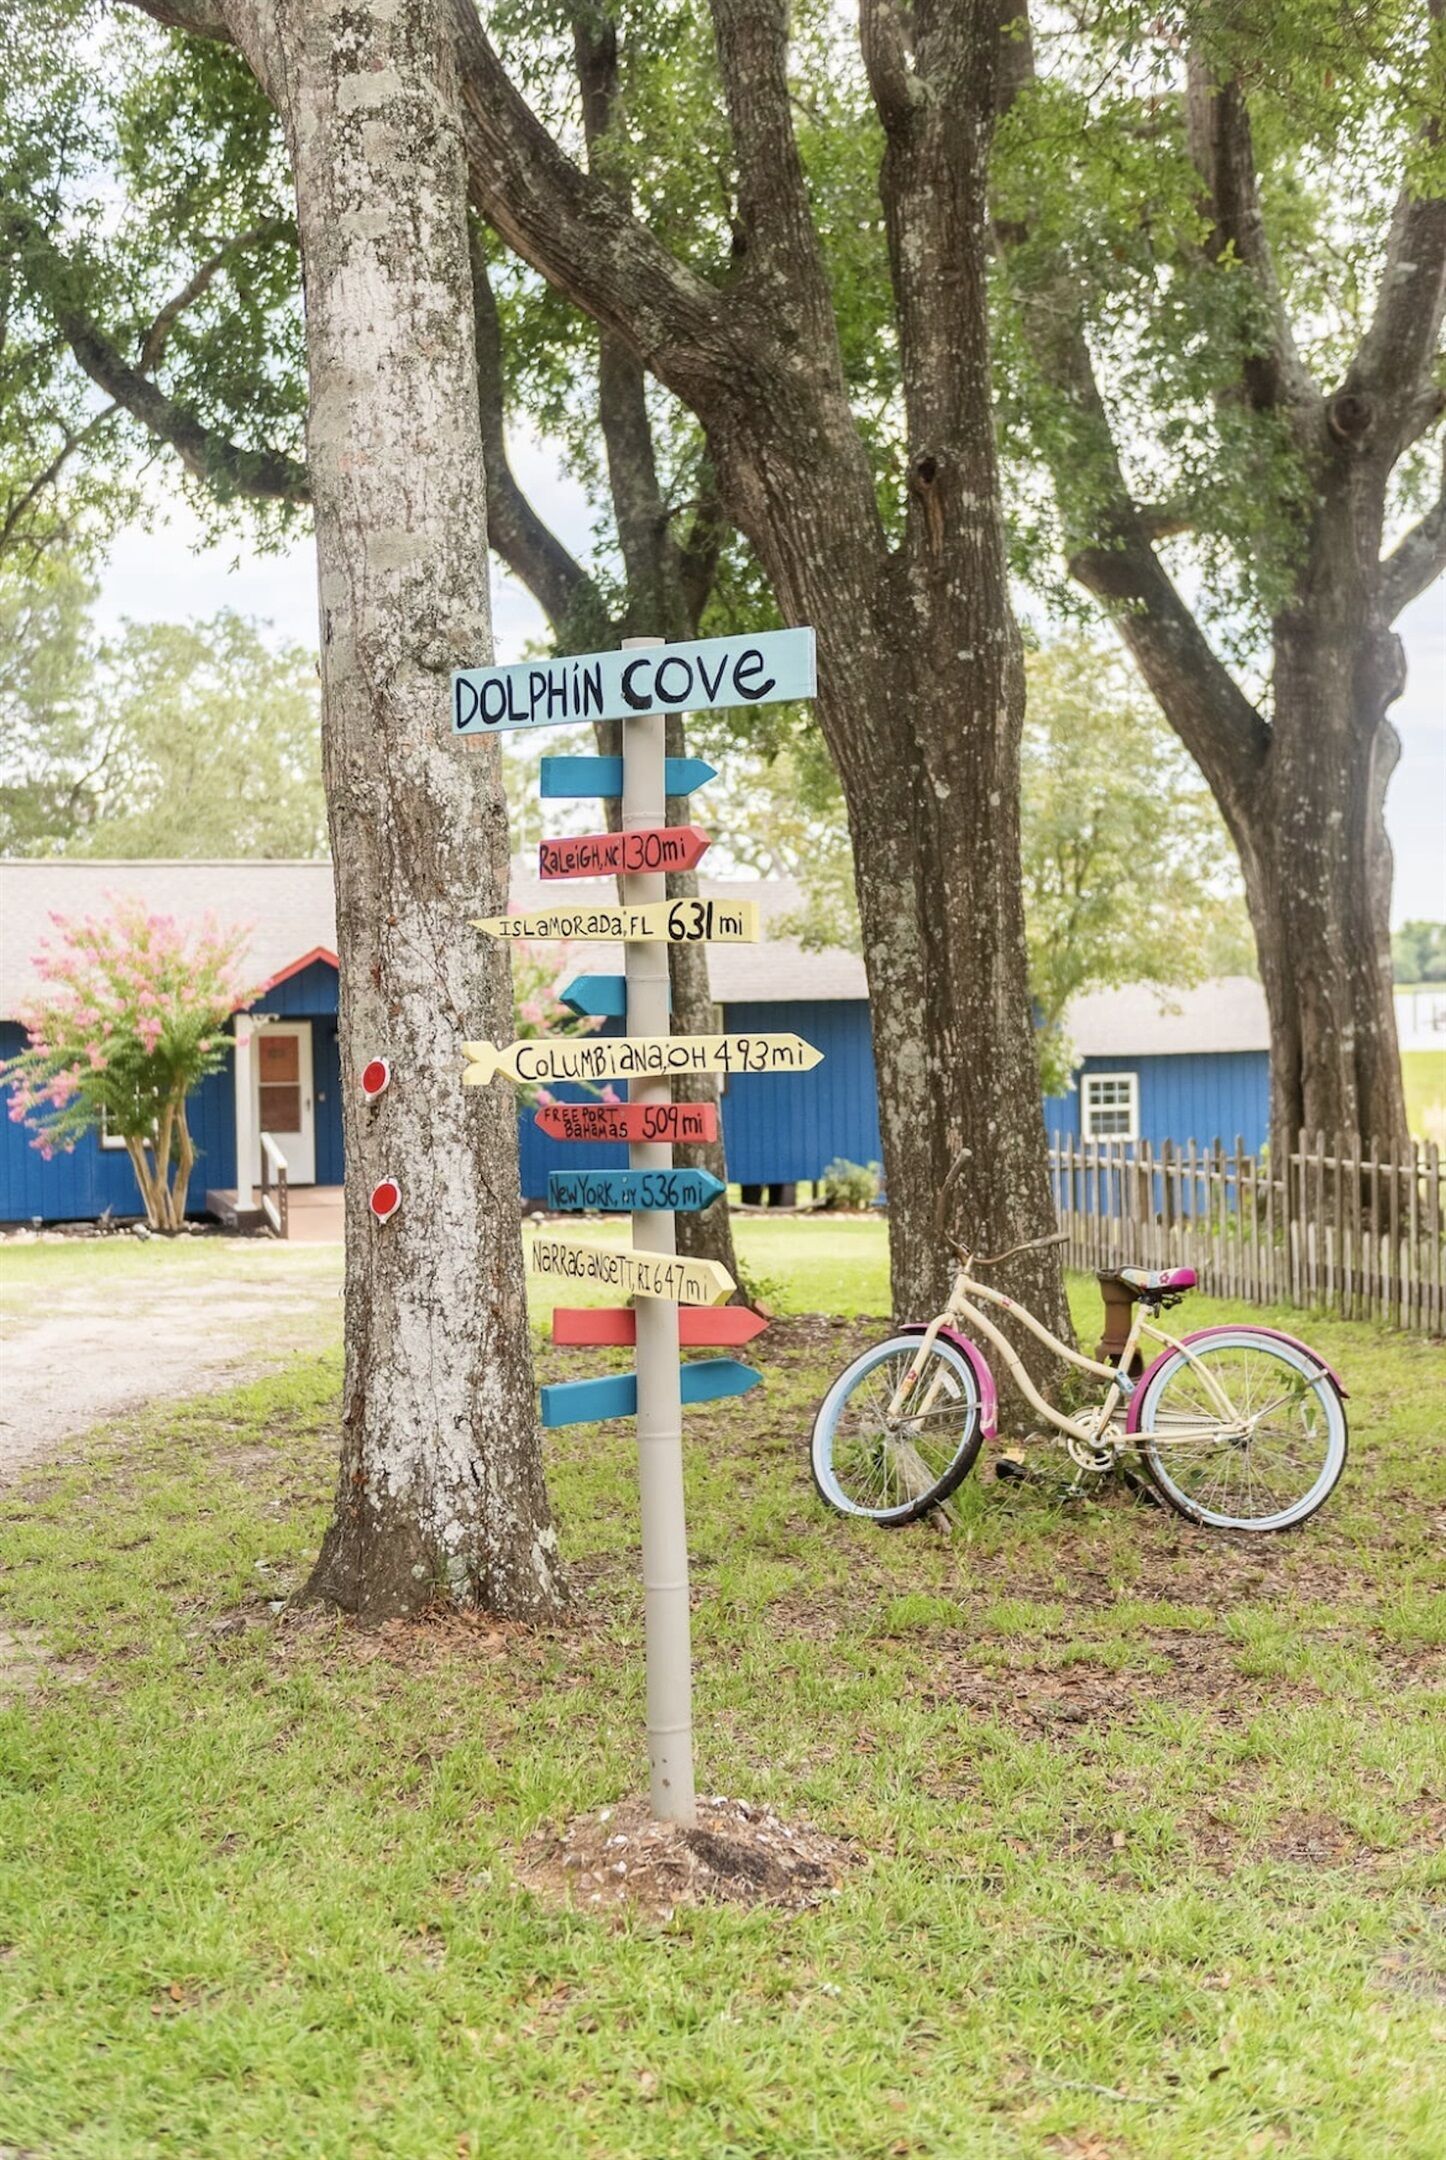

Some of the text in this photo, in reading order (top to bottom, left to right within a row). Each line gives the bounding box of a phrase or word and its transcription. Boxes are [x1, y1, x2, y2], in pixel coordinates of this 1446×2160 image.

[622, 833, 661, 871] 130
[662, 837, 685, 862] mi
[668, 901, 713, 940] 631
[719, 912, 743, 936] mi
[714, 1039, 769, 1072] 493
[773, 1042, 804, 1066] mi
[642, 1106, 703, 1139] 509 mi
[641, 1174, 679, 1208] 536
[682, 1181, 703, 1205] mi
[653, 1263, 685, 1301] 647
[686, 1275, 708, 1301] mi
